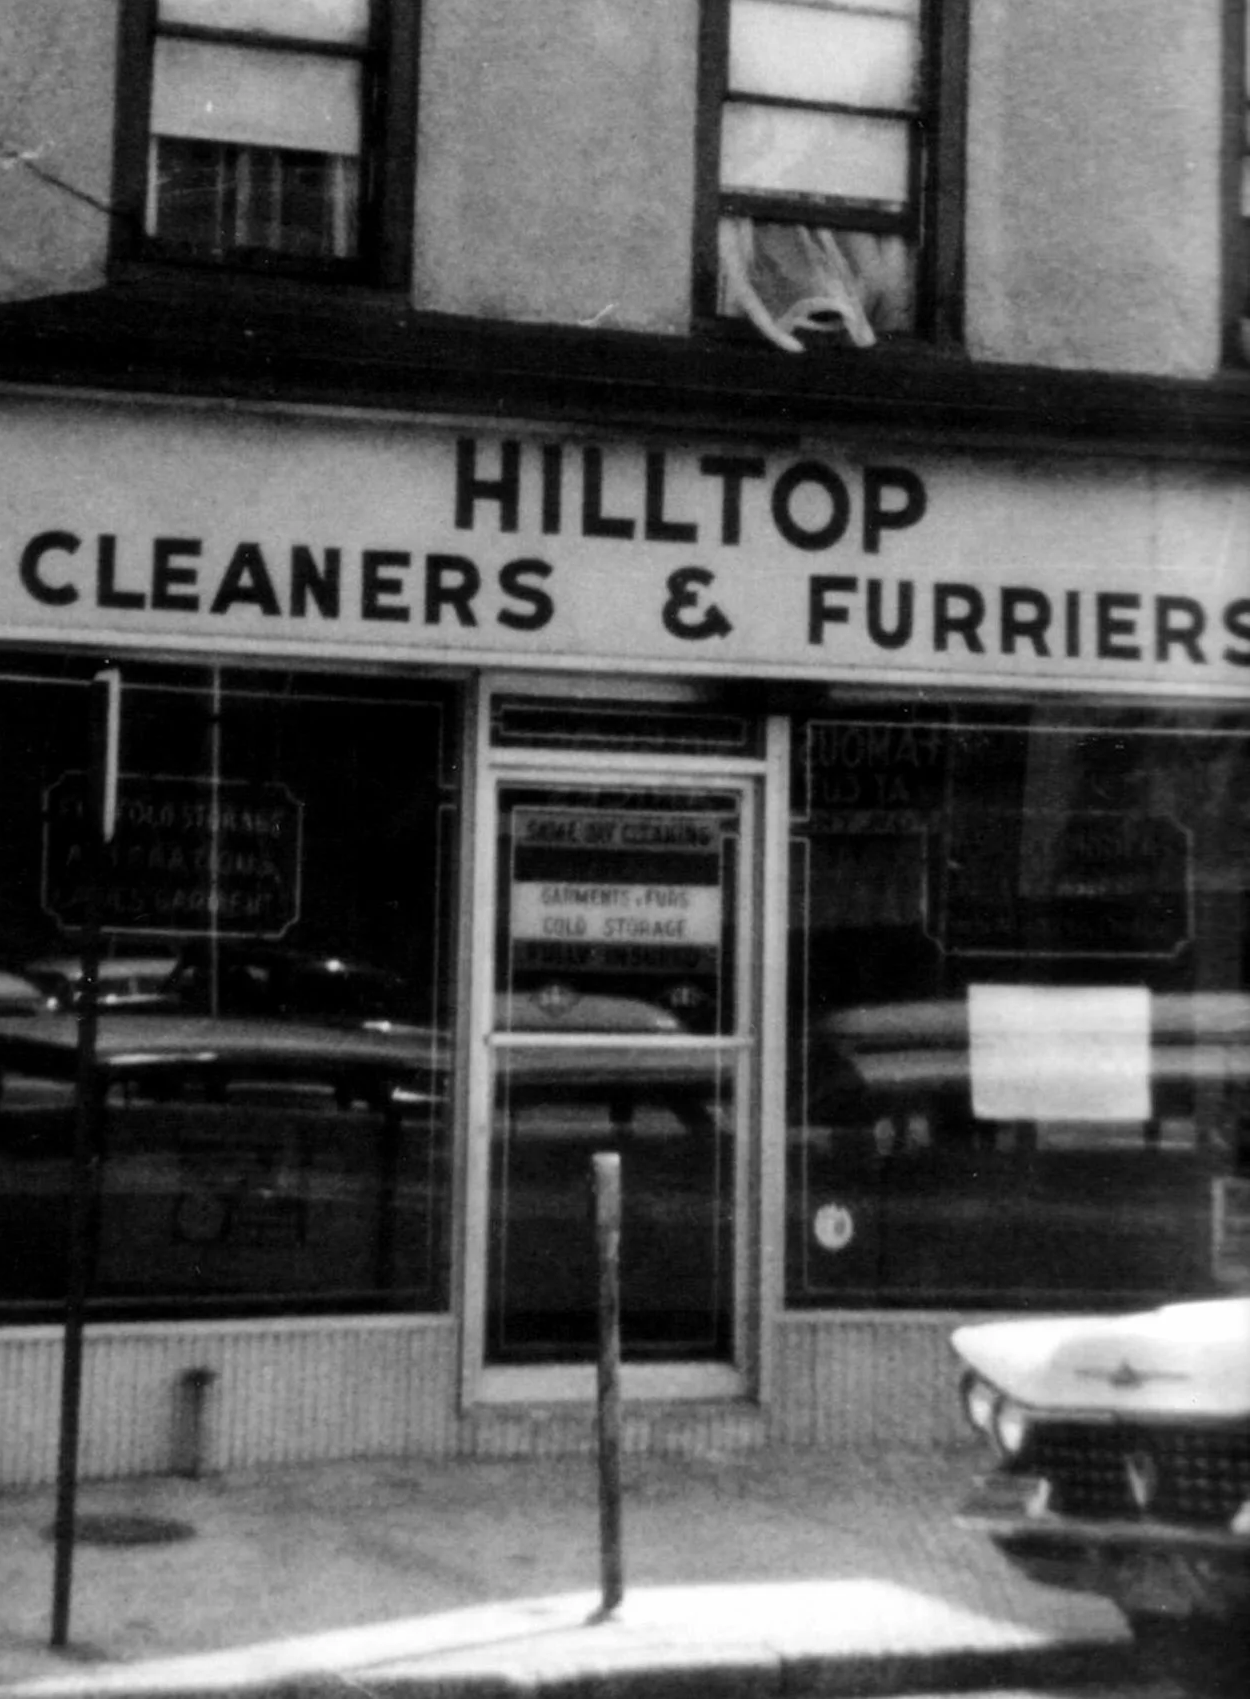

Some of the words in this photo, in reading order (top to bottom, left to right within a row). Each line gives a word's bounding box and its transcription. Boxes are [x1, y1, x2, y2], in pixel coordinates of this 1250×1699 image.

[455, 438, 927, 554] HILLTOP
[19, 530, 555, 632] CLEANERS
[661, 566, 734, 640] &
